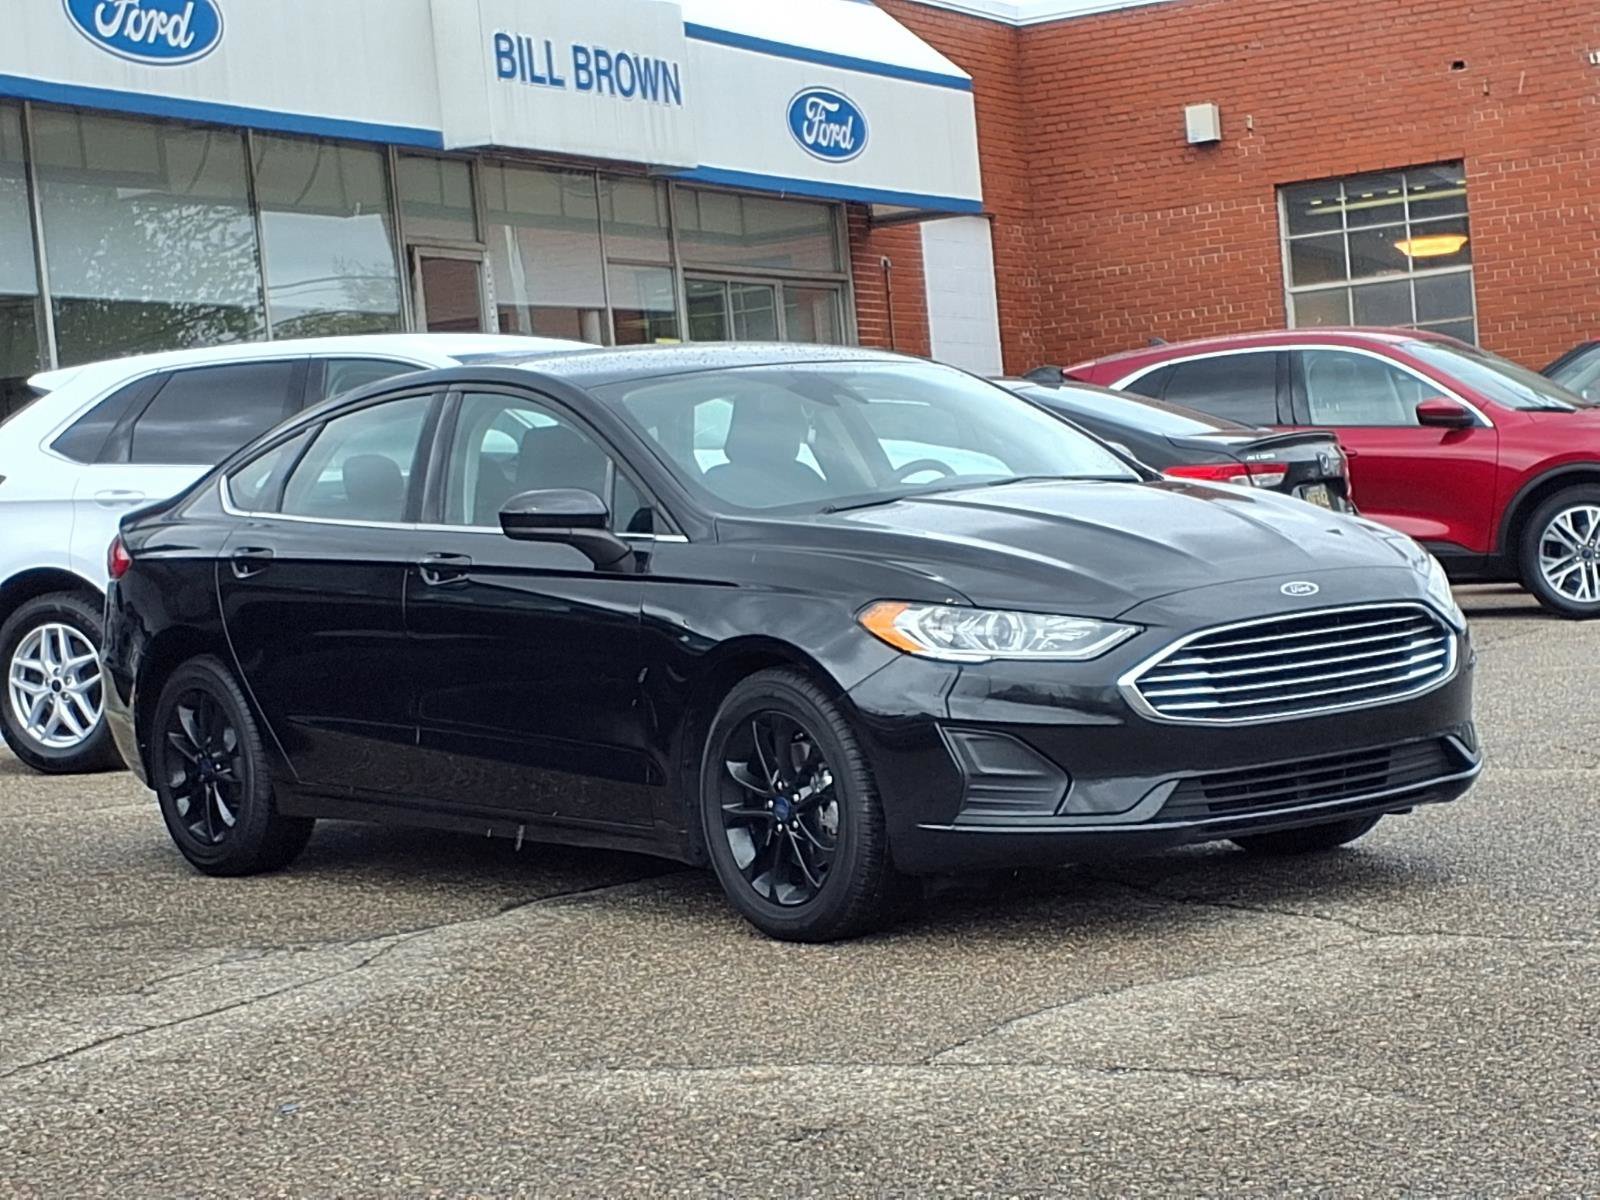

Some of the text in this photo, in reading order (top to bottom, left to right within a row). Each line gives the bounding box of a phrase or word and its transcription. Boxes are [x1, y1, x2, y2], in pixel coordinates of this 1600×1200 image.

[494, 32, 682, 106] BILL BROWN
[803, 96, 854, 150] Ford
